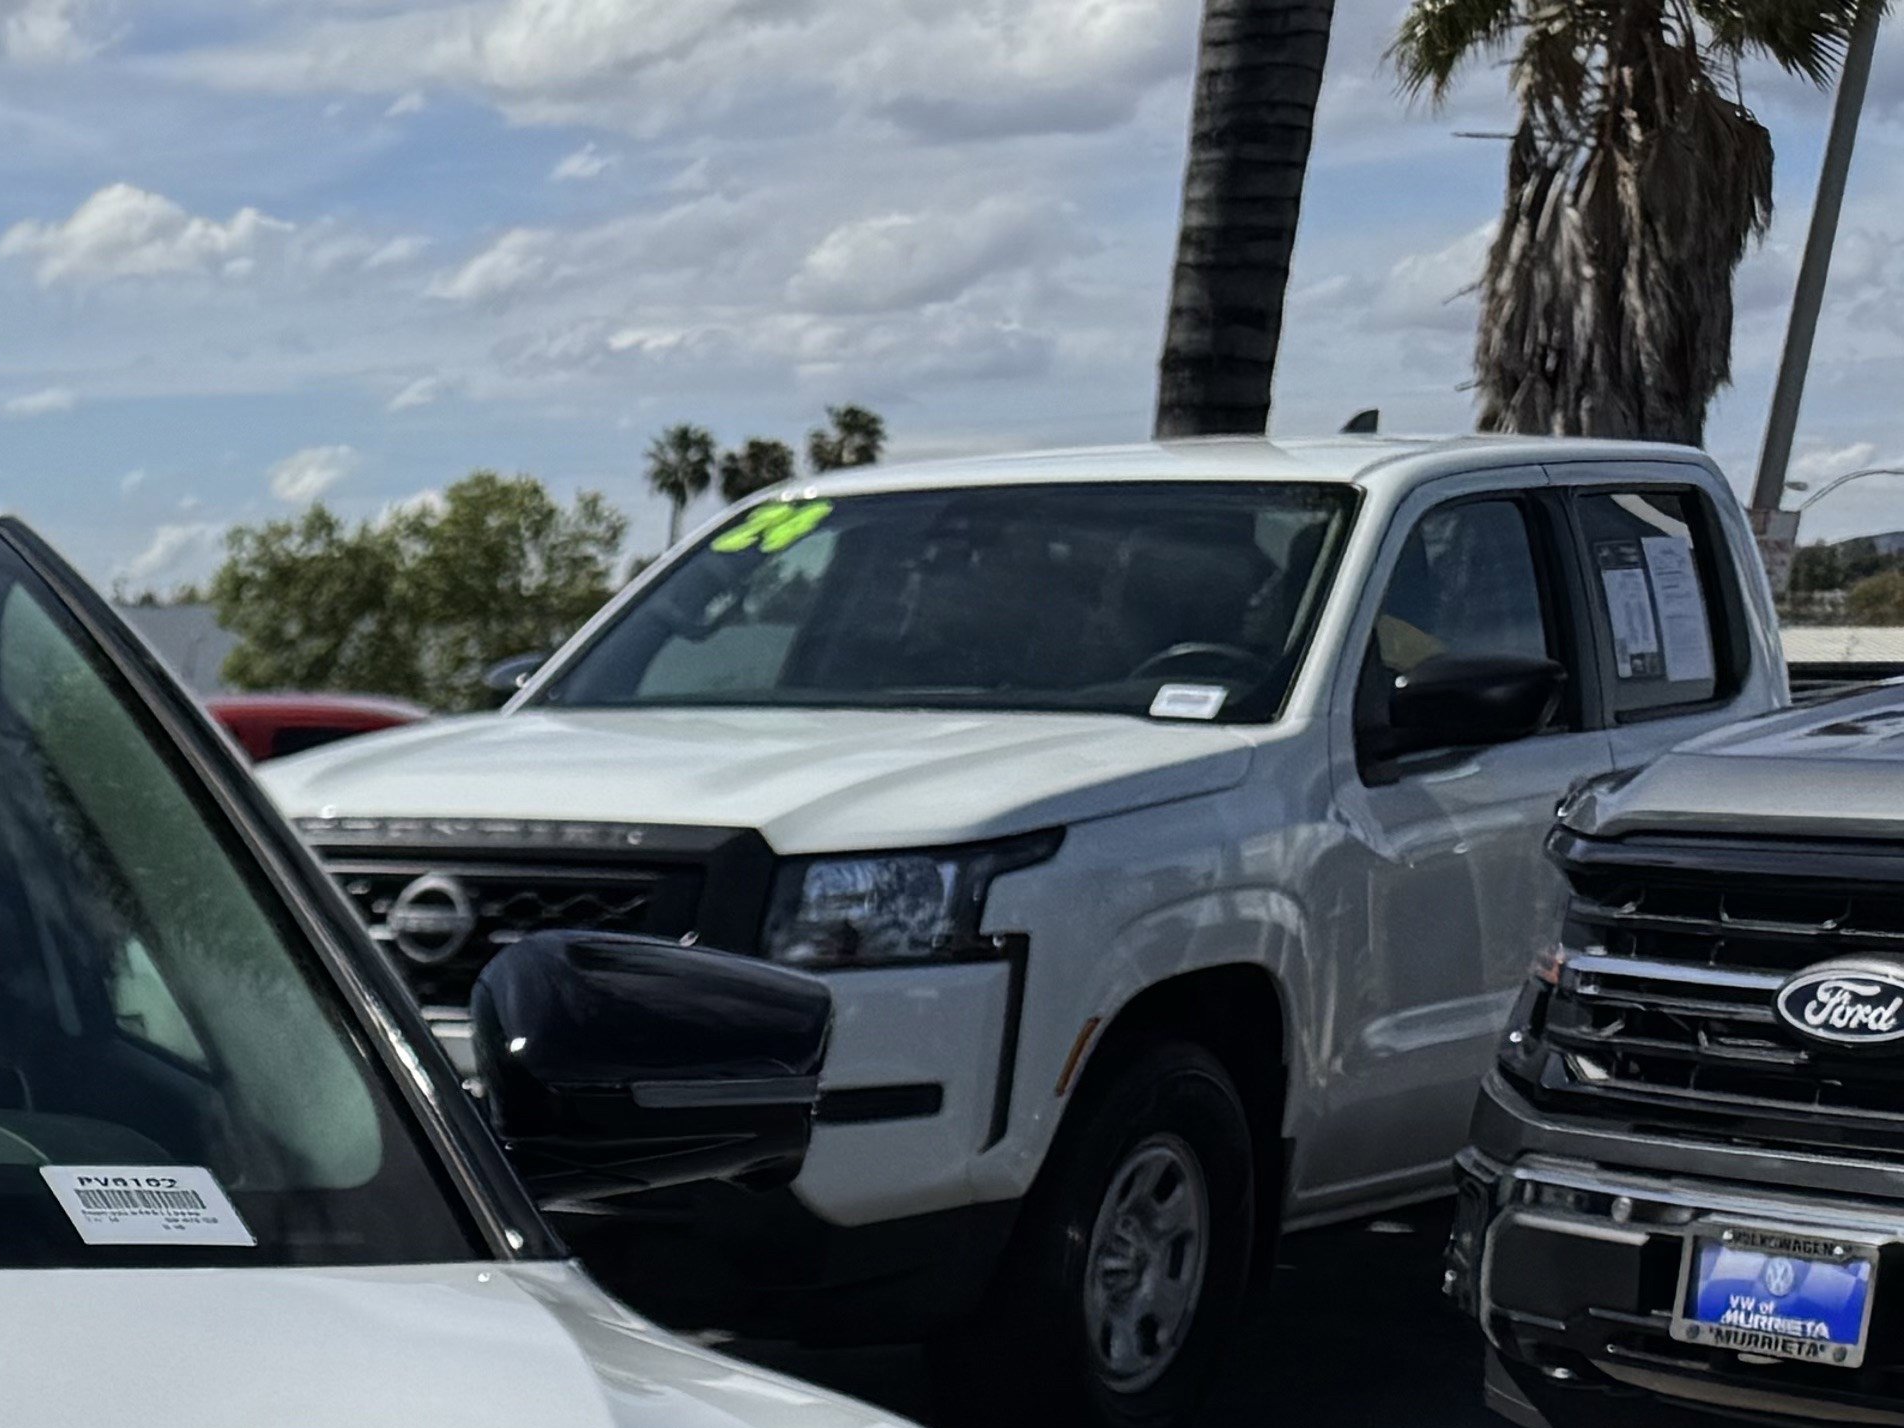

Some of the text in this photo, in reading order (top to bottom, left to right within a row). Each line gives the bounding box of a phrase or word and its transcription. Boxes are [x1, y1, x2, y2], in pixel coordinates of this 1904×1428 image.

[1803, 980, 1903, 1031] Ford
[1729, 1294, 1775, 1314] VW of
[1720, 1309, 1830, 1339] MURRIETA
